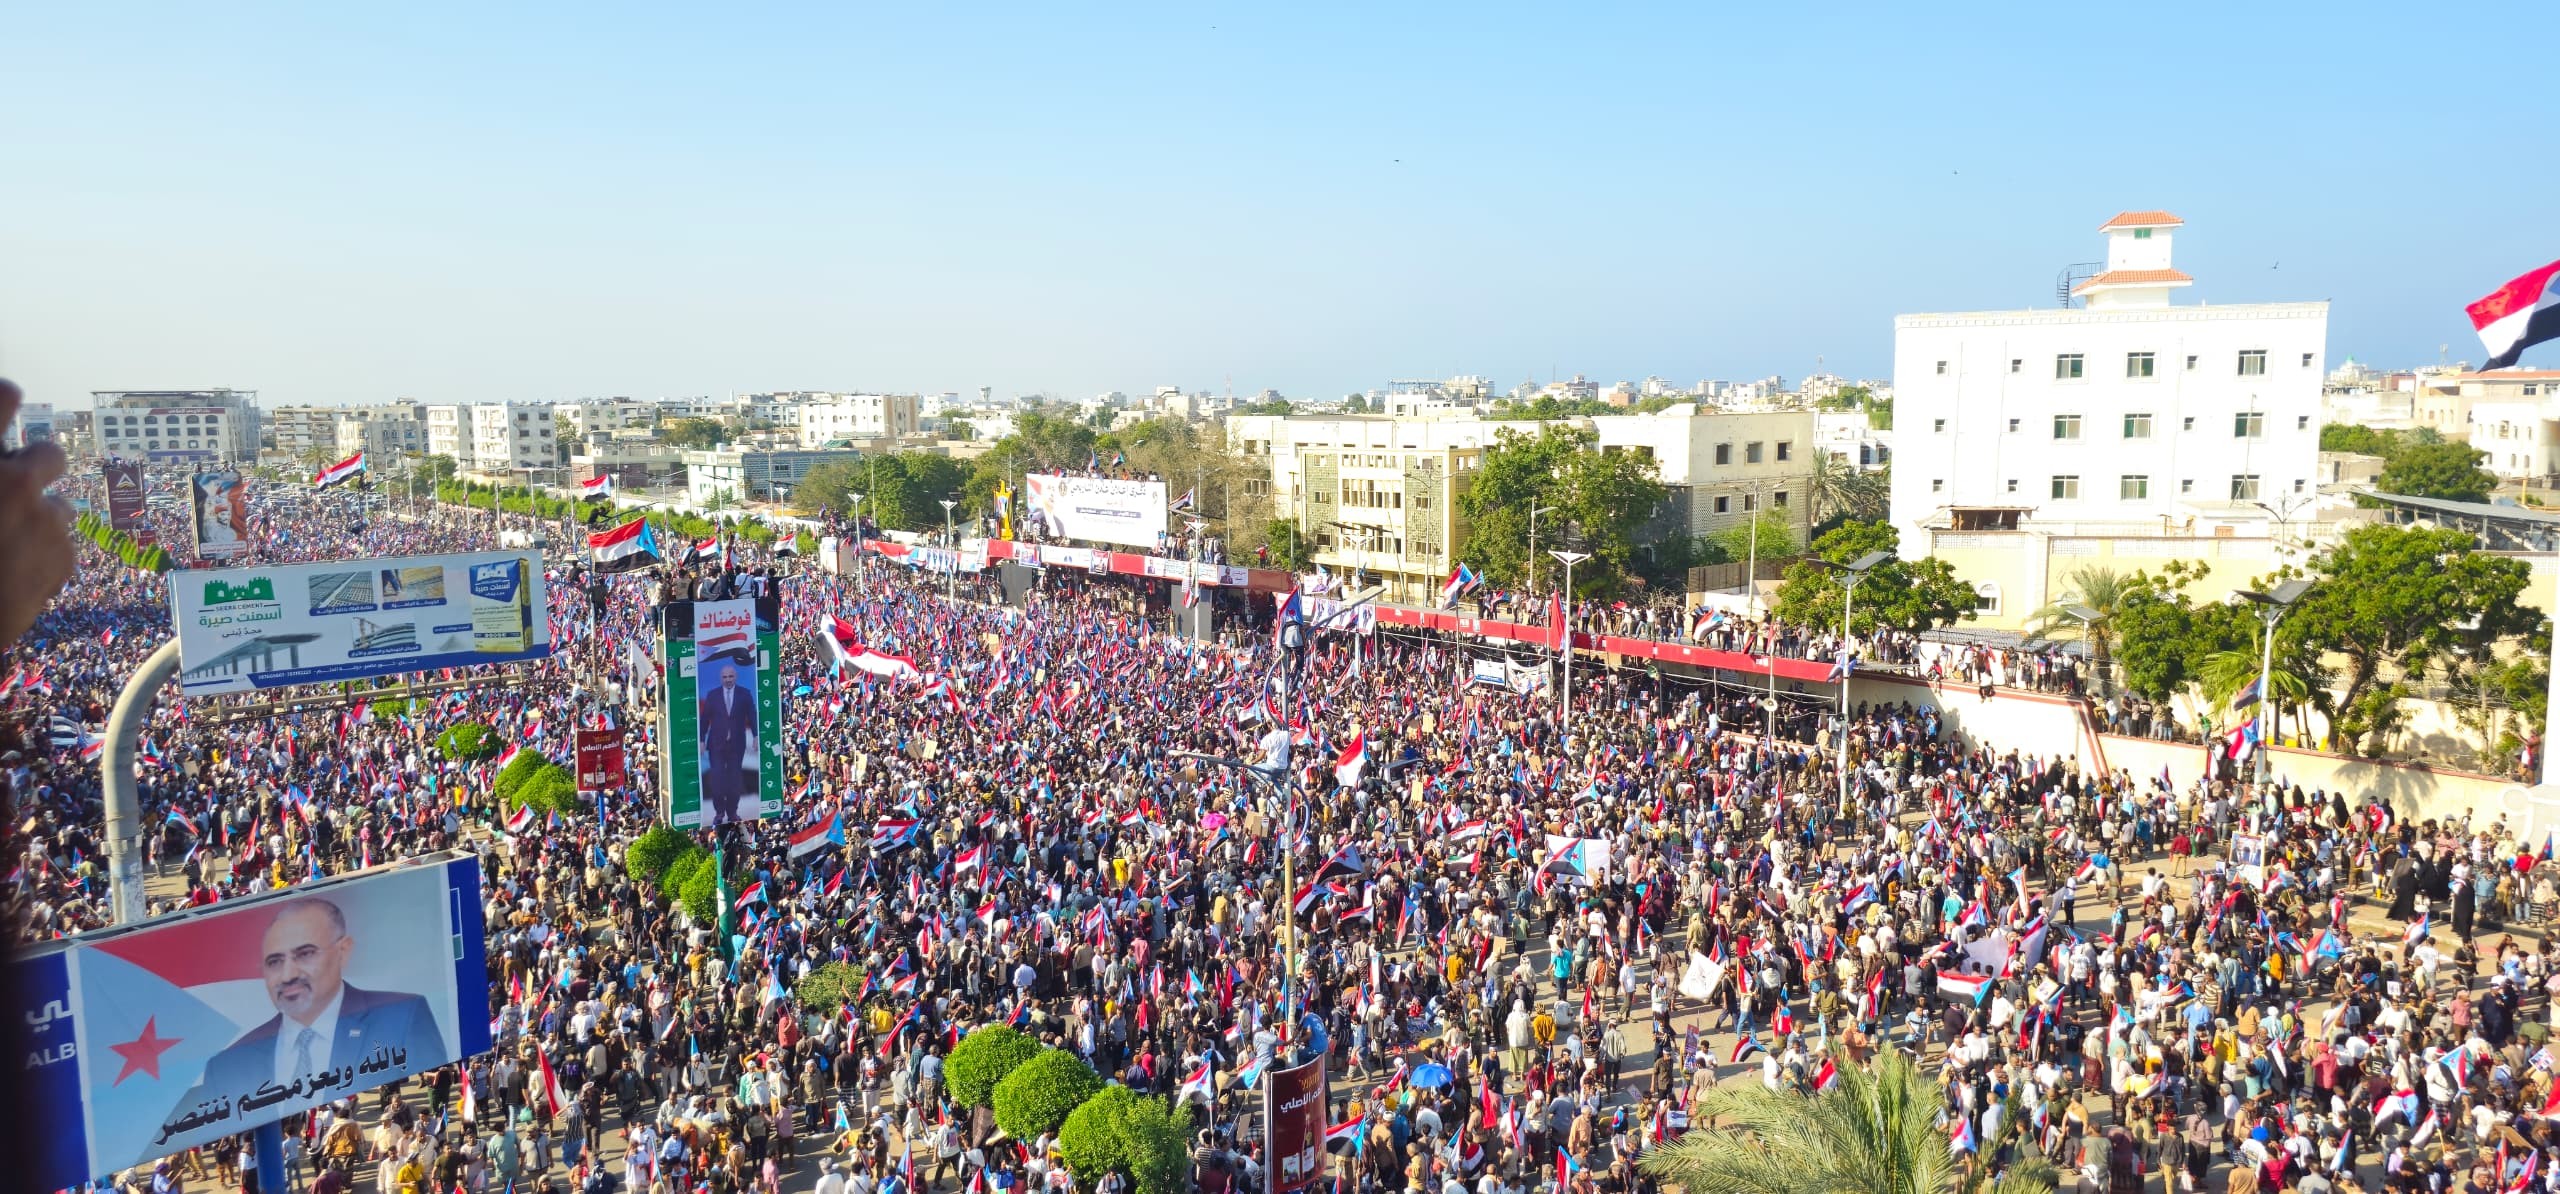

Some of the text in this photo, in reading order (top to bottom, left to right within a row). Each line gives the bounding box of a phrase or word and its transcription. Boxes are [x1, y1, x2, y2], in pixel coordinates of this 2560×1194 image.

[199, 615, 233, 628] صيرة
[698, 608, 752, 631] فوضناك
[237, 1064, 354, 1121] وبعزمكم
[154, 1095, 231, 1146] ننتصر
